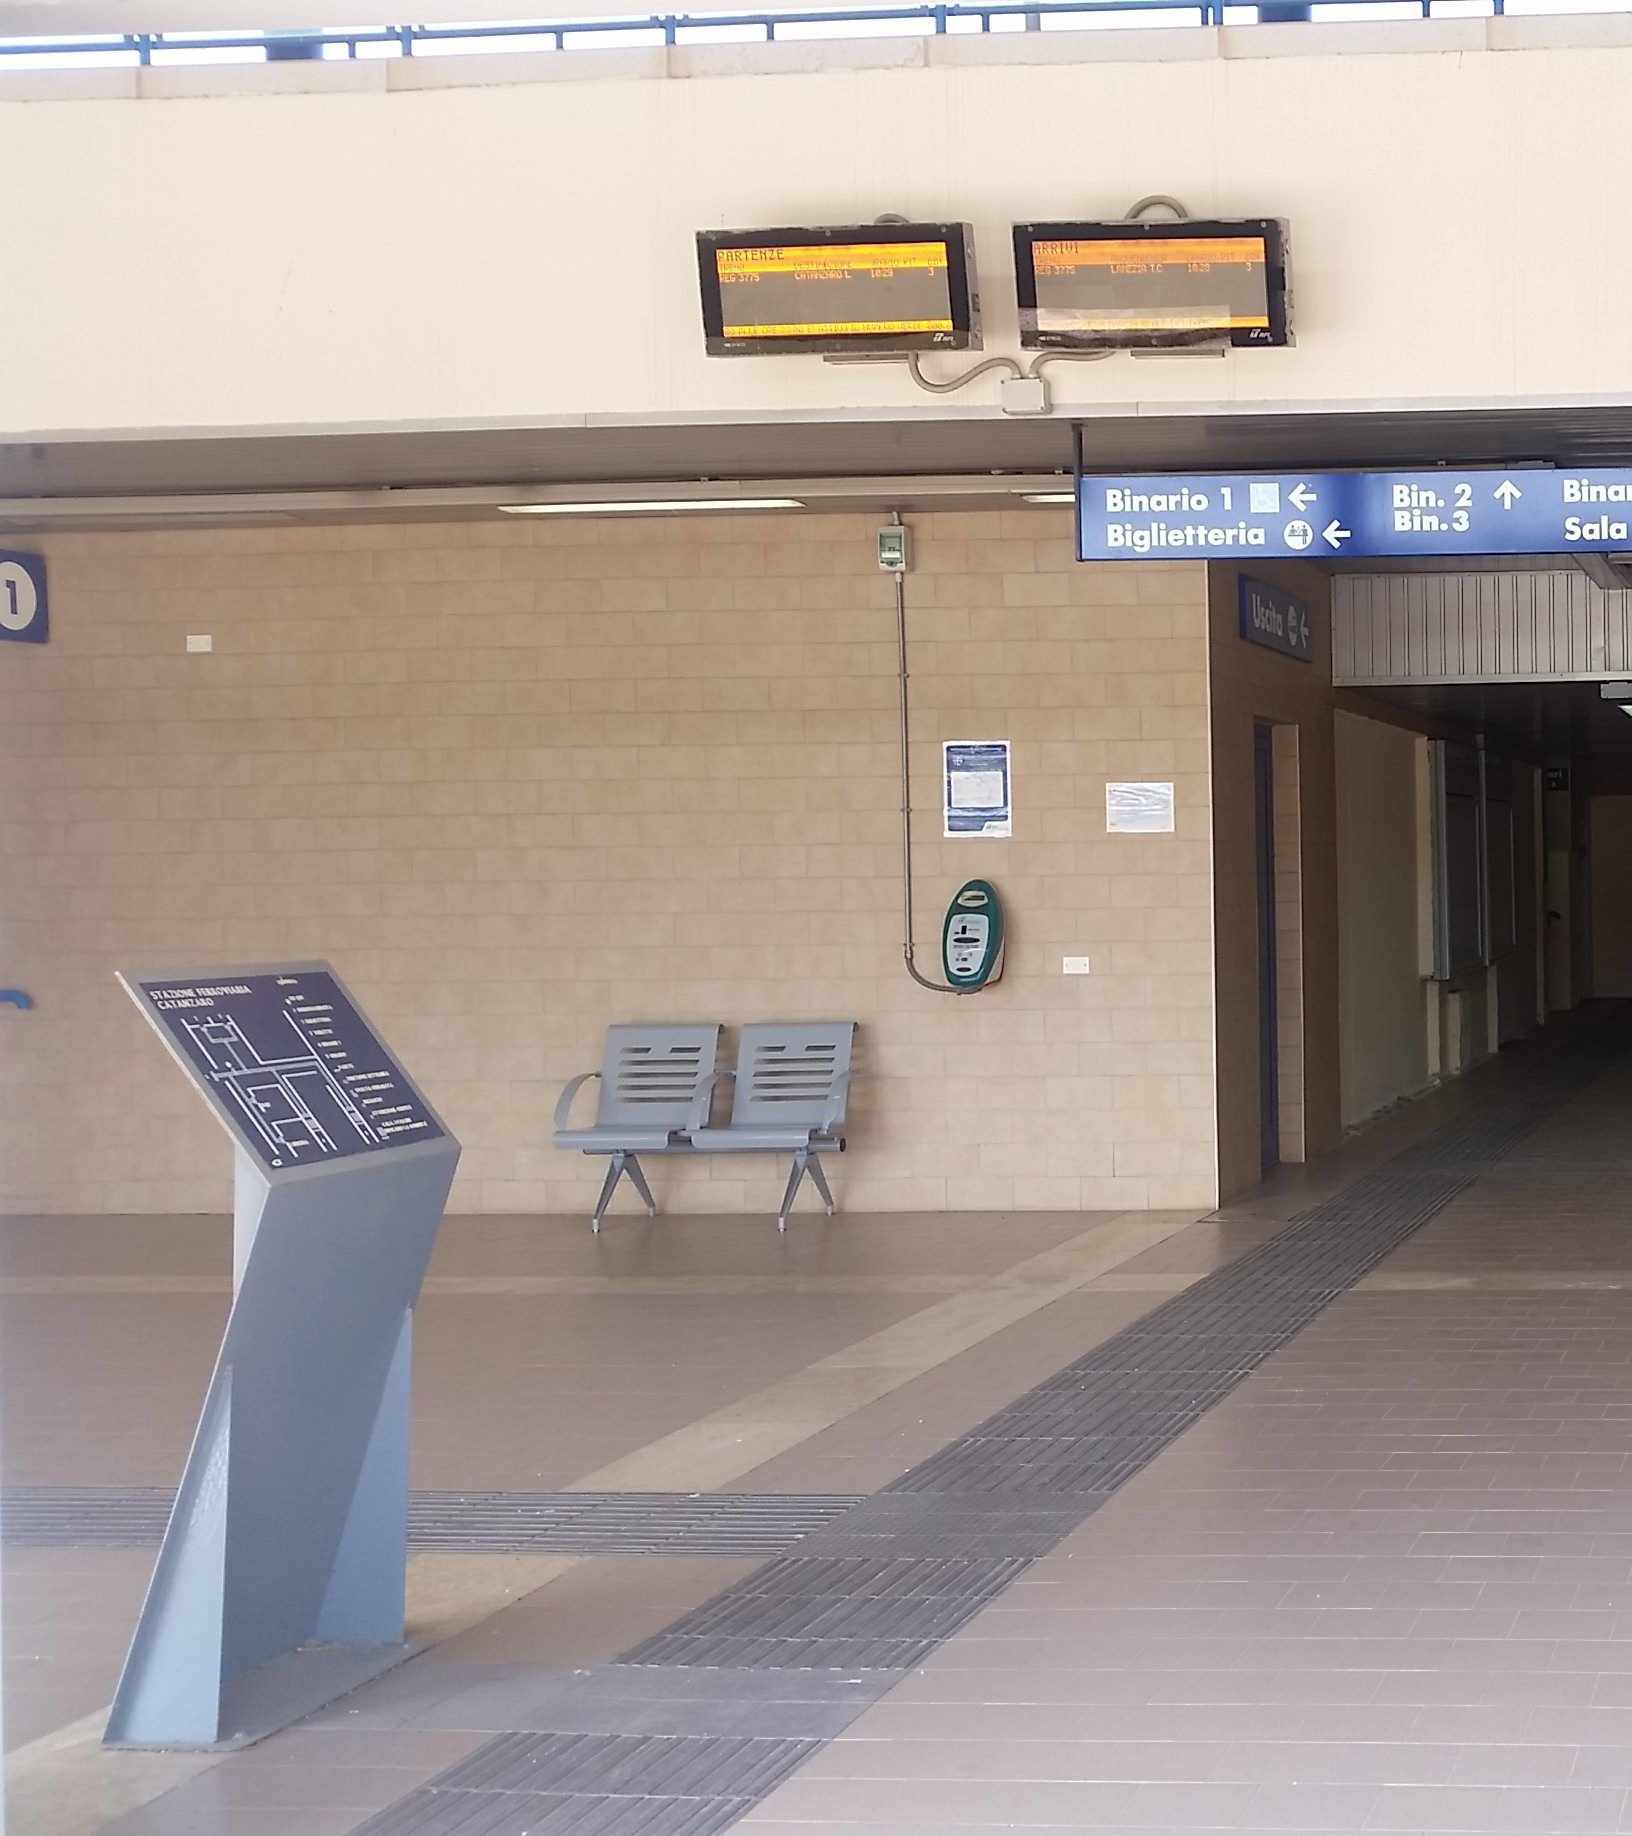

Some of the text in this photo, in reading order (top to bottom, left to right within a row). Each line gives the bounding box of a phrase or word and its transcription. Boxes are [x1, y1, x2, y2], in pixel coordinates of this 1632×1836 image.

[717, 248, 785, 262] PARTENZE
[1033, 242, 1079, 254] ARRIVI
[927, 266, 934, 276] 3
[1245, 262, 1253, 272] 3
[1106, 486, 1232, 513] Binario 1
[1392, 483, 1473, 509] Bin. 2
[1106, 521, 1266, 553] Biglietteria
[1564, 515, 1628, 542] Sala
[5, 578, 18, 615] 1
[149, 984, 253, 1001] STAZIONE FERROVIARIA
[156, 997, 215, 1010] CATANZARO
